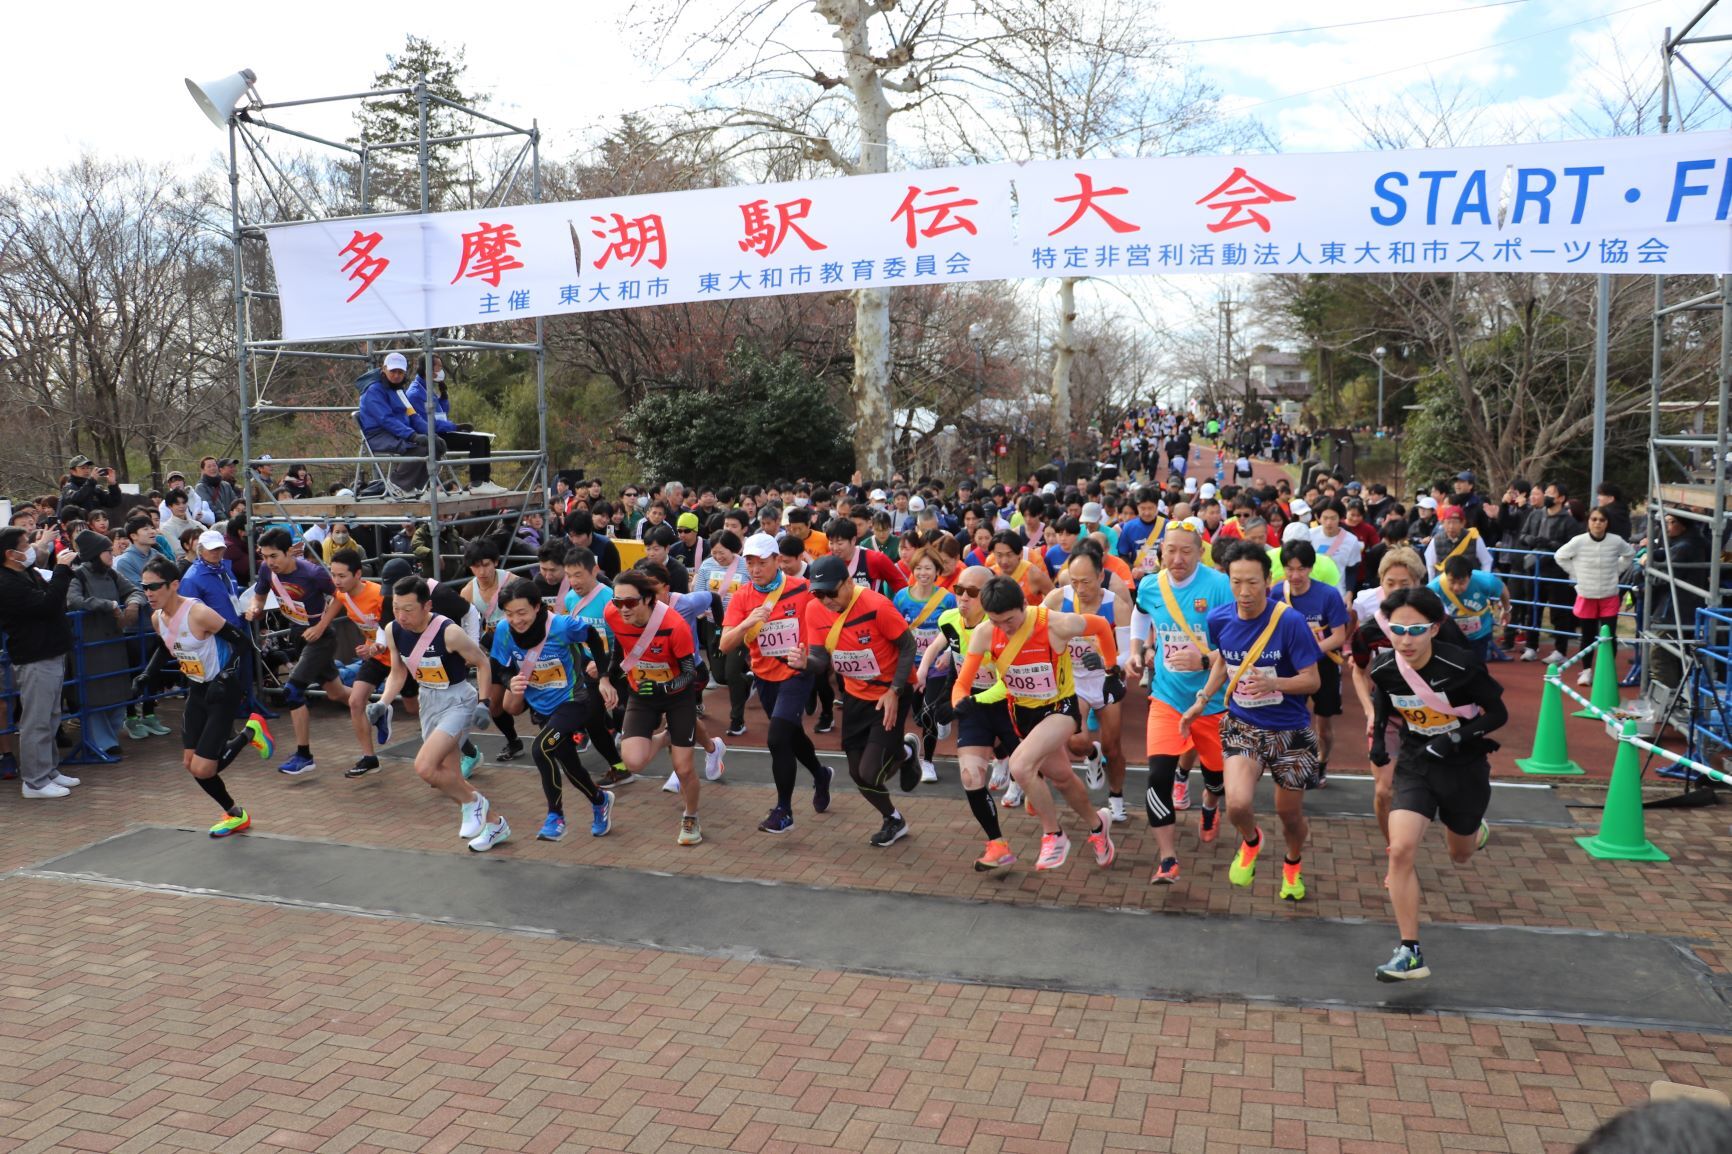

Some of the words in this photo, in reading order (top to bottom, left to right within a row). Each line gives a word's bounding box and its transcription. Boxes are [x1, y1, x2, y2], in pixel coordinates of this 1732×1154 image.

[339, 166, 1296, 302] 多摩湖駅伝大会
[479, 288, 530, 315] 主催
[560, 276, 669, 305] 東大和市
[700, 252, 971, 293] 東大和市教育委員会
[1032, 234, 1671, 269] 特定非営利活動法人東大和市スポーツ協会
[1160, 622, 1202, 632] QAR
[759, 631, 797, 647] 201-1
[834, 660, 875, 673] 202-1
[1006, 674, 1051, 690] 208-1
